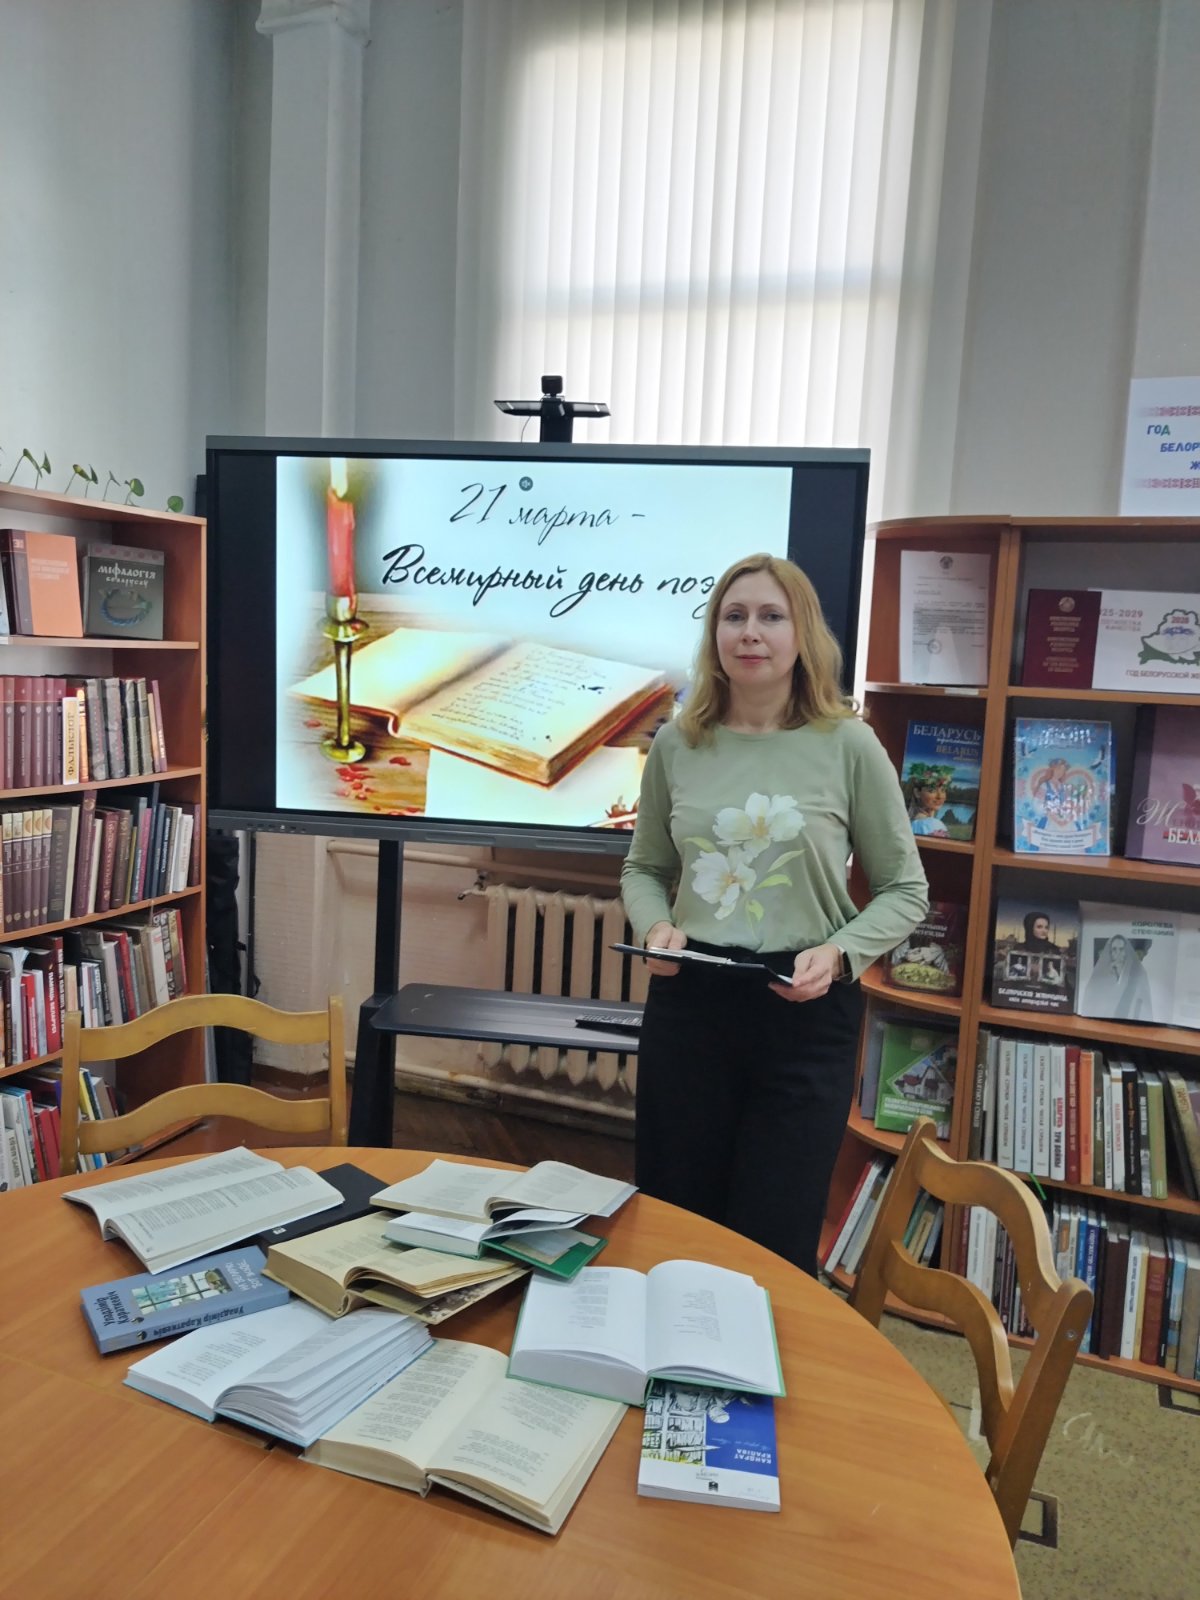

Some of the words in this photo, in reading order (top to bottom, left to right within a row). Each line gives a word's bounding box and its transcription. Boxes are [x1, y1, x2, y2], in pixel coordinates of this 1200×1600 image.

[1147, 425, 1171, 436] ГОД
[1190, 461, 1200, 470] Ж
[449, 483, 507, 523] 21
[509, 505, 620, 545] марта
[382, 543, 567, 606] Всемирный
[550, 572, 644, 618] день
[1099, 608, 1143, 618] 25-2029
[1125, 669, 1139, 677] ГОД
[1139, 669, 1190, 679] БЕЛОРУССКОЙ
[1190, 671, 1200, 679] ЖЕ
[912, 724, 982, 741] БЕЛАРУСЬ
[94, 1296, 115, 1327] Уладзімір
[107, 1290, 130, 1325] Караткевіч
[203, 1305, 244, 1322] Уладзімір
[153, 1317, 202, 1337] Караткевіч
[734, 1454, 772, 1464] КАНДРАТ
[736, 1448, 772, 1459] КРАПІВА
